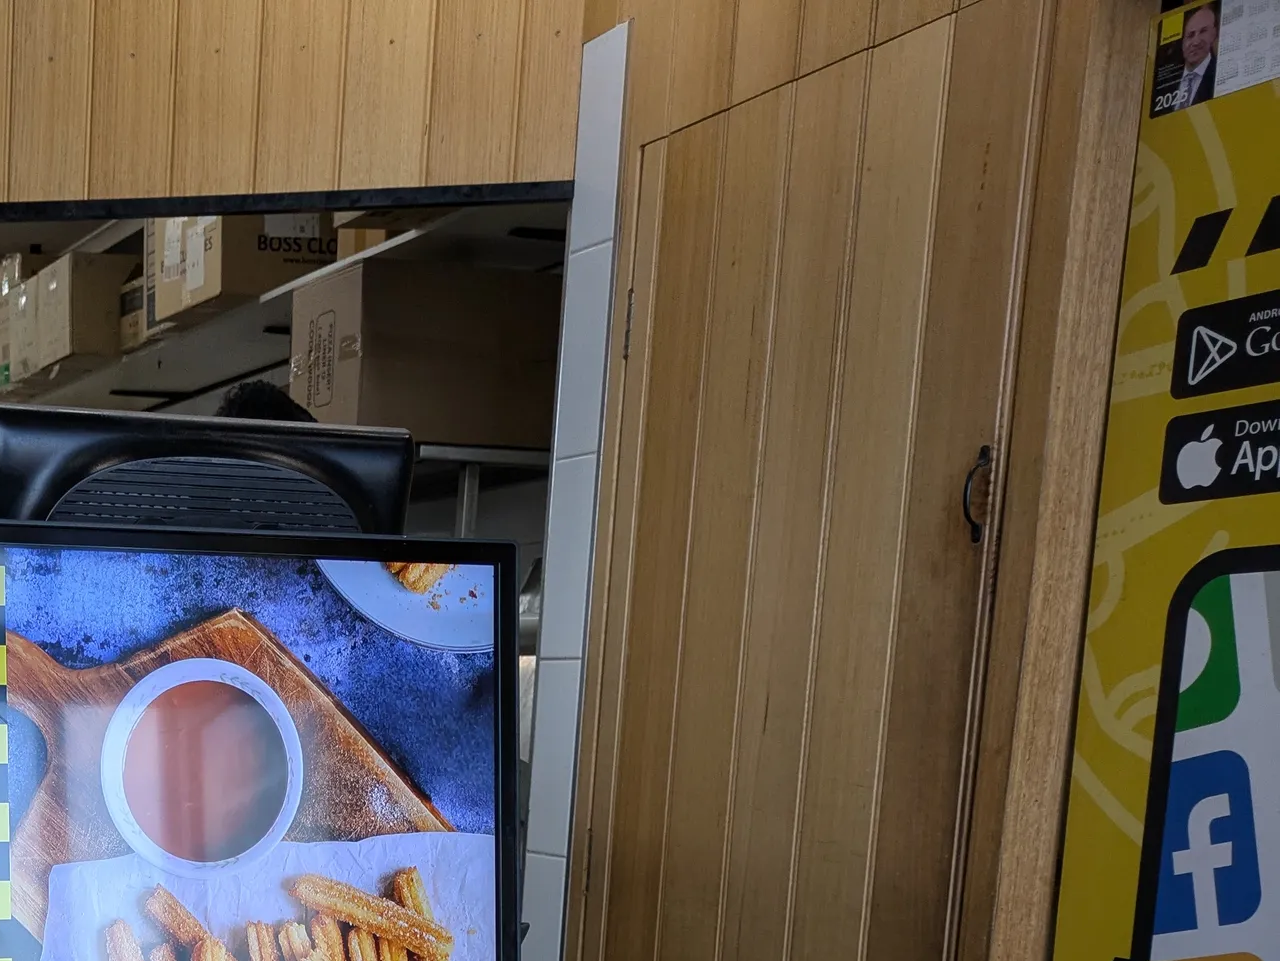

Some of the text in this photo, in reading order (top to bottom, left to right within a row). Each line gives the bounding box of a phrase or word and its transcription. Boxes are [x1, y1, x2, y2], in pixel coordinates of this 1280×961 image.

[1154, 89, 1189, 111] 2025
[257, 234, 302, 252] BOSS
[1249, 308, 1280, 323] ANDR
[1234, 419, 1280, 437] Dow
[1230, 440, 1280, 481] Ap
